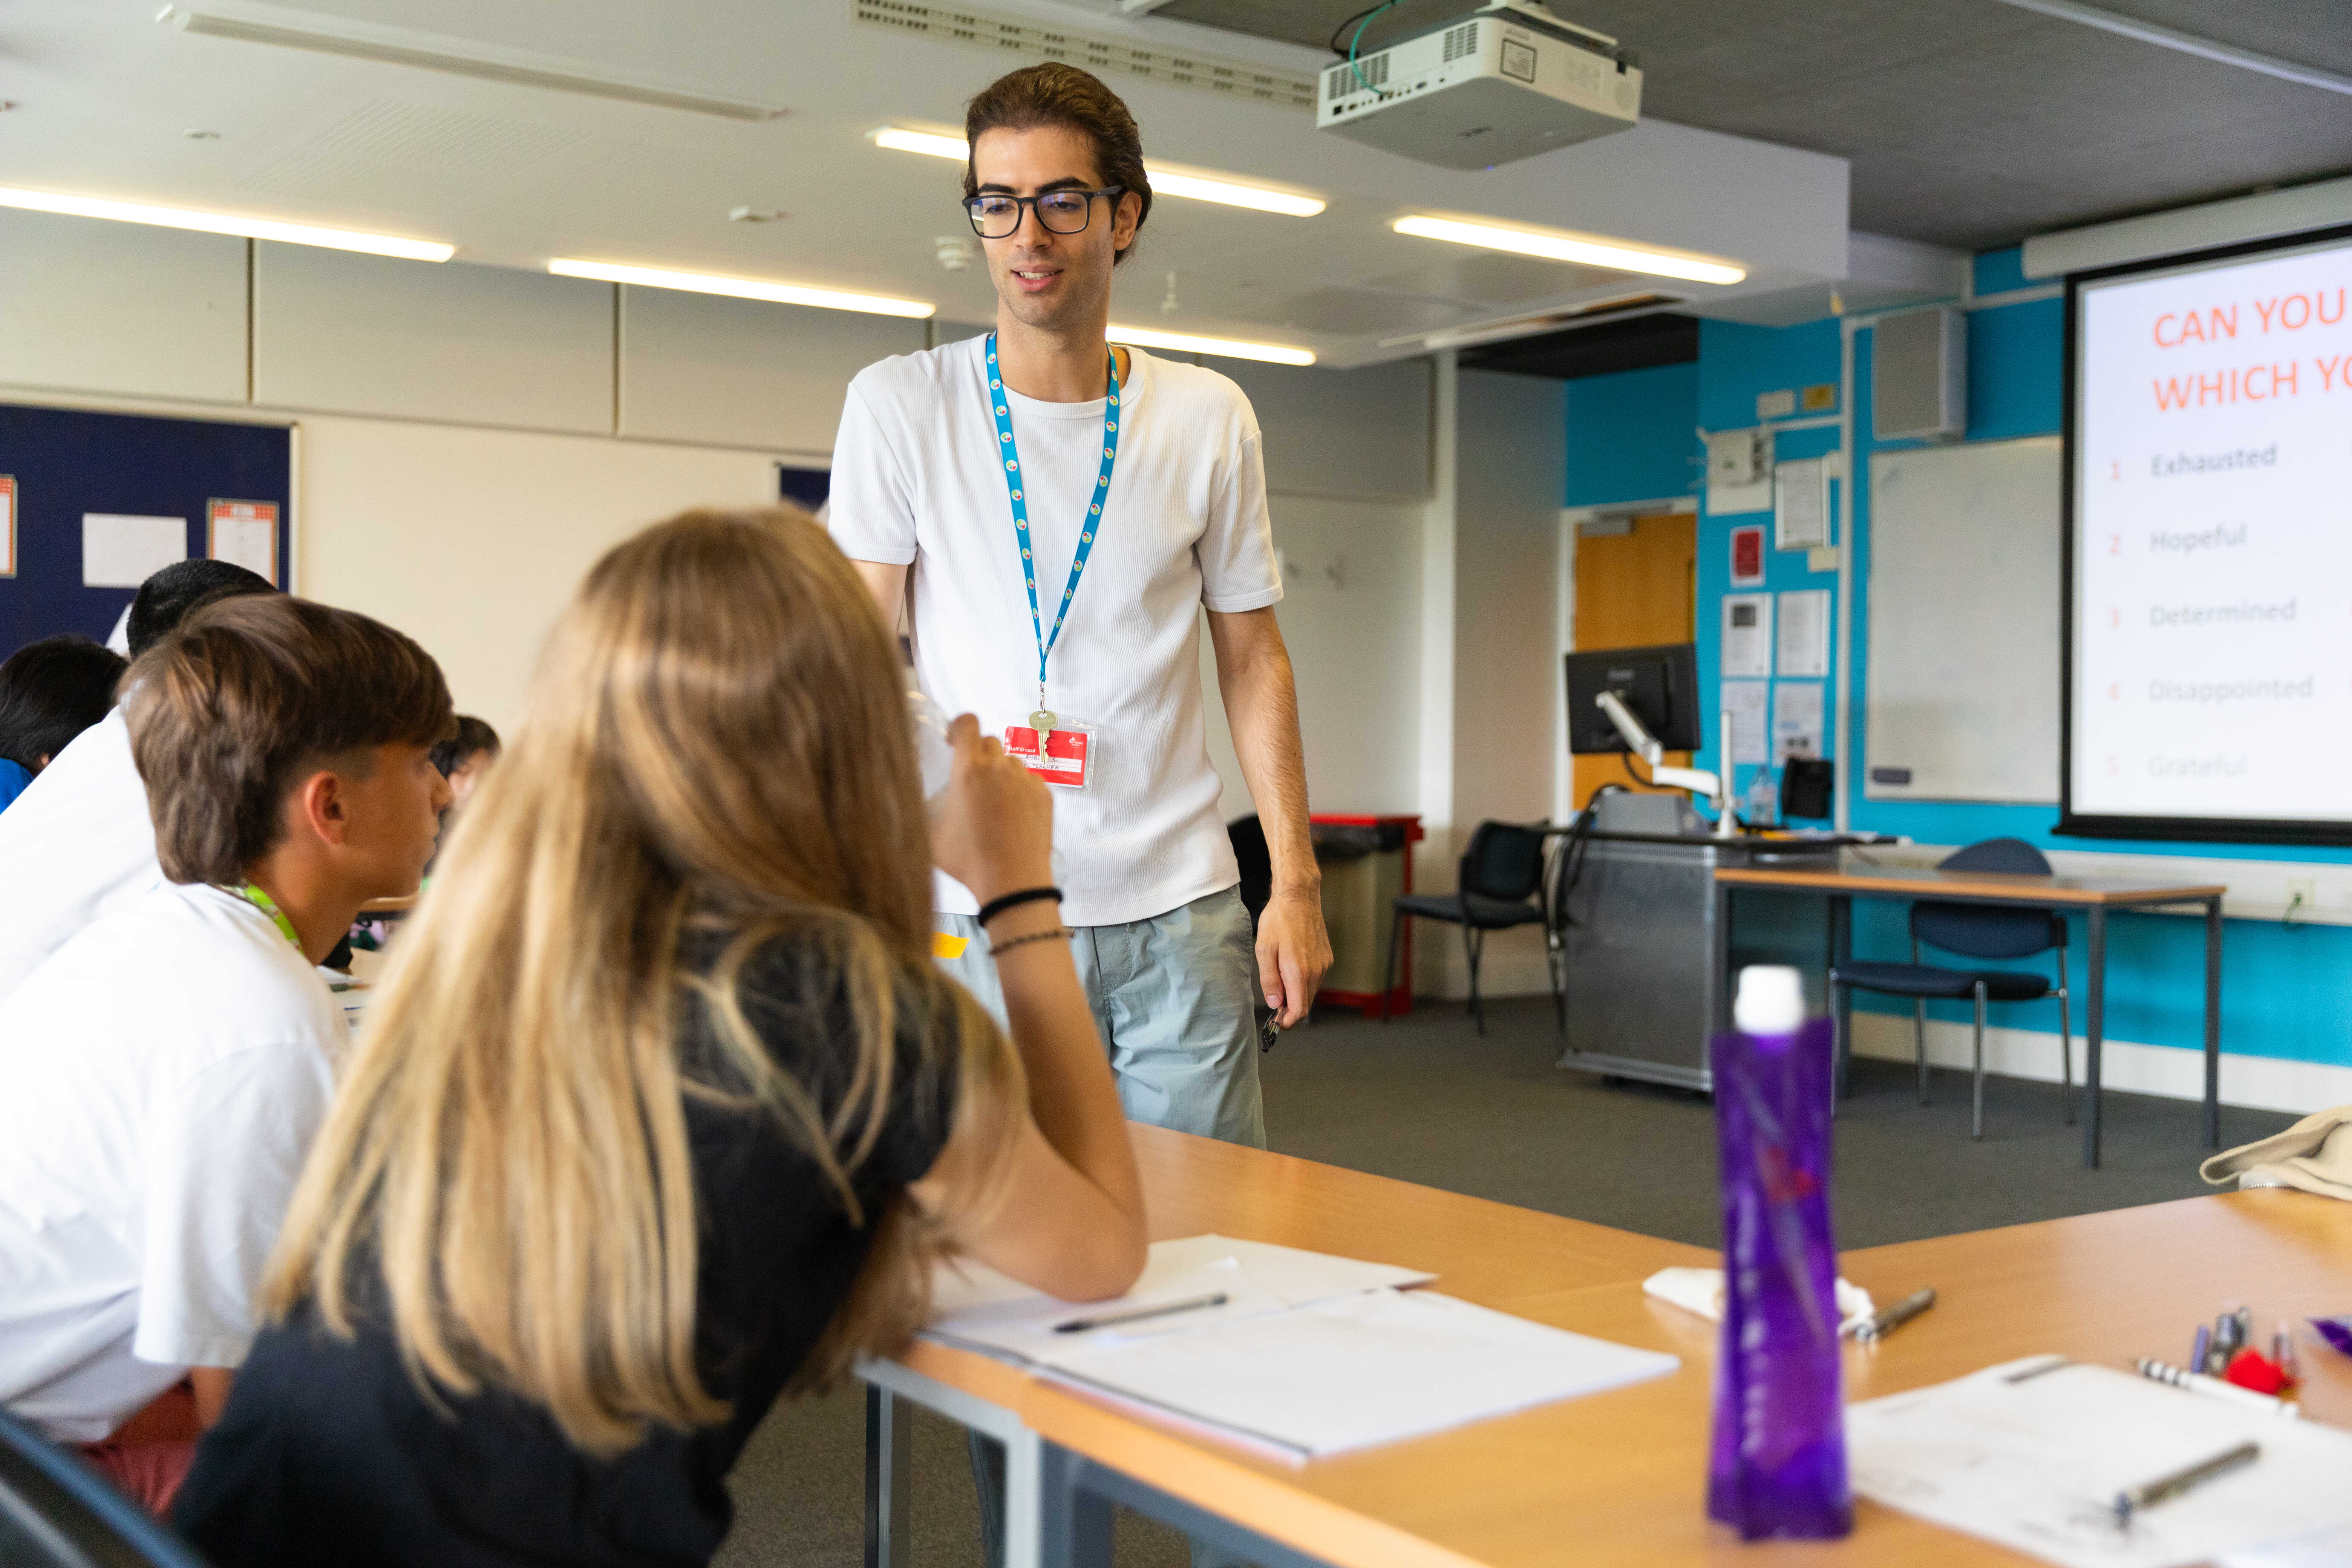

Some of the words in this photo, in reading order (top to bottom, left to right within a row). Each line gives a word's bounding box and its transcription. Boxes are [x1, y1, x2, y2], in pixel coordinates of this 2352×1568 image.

[2153, 305, 2237, 348] CAN
[2254, 287, 2346, 334] YOU
[2152, 361, 2298, 412] WHICH
[2109, 460, 2121, 482] 1
[2151, 442, 2277, 478] Exhausted
[2108, 532, 2121, 556] 2
[2150, 523, 2246, 555] Hopeful
[2109, 606, 2121, 629] 3
[2150, 597, 2297, 628] Determined
[2106, 681, 2121, 701] 4
[2150, 675, 2314, 705] Disappointed
[2147, 751, 2246, 780] Grateful
